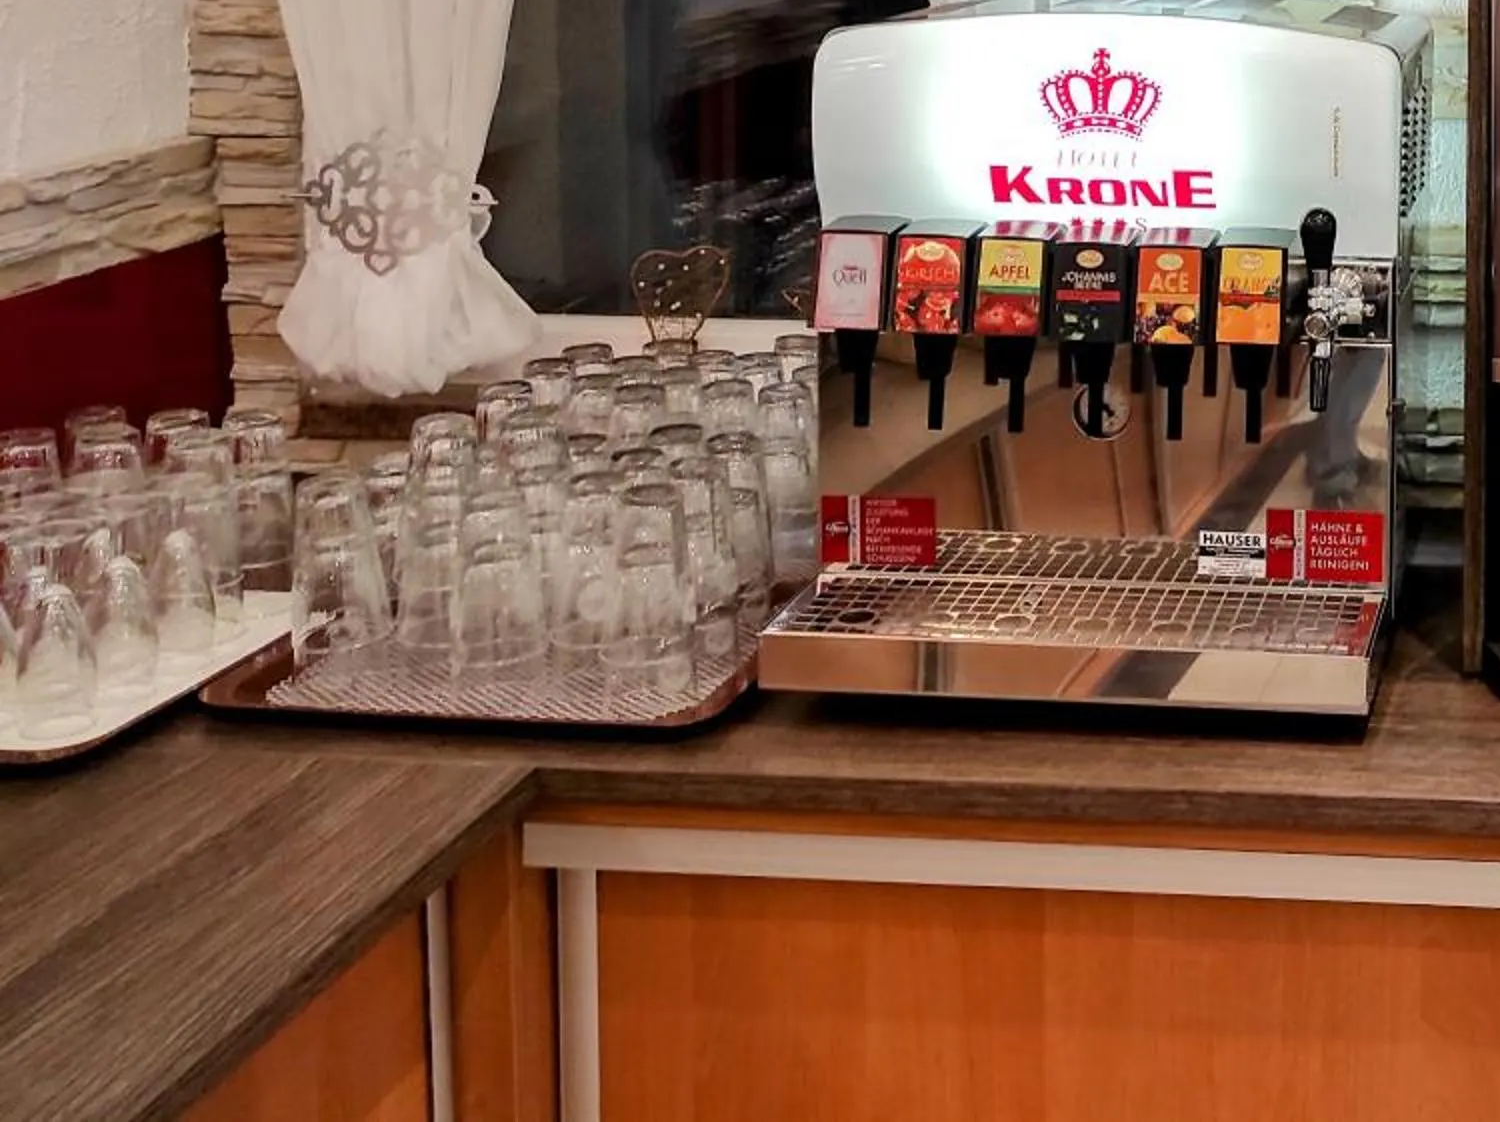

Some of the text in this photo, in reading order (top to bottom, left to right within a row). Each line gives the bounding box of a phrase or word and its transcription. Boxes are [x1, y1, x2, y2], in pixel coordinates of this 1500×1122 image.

[989, 164, 1217, 209] KRONE
[989, 263, 1031, 281] APFEL
[1147, 271, 1190, 293] ACE
[1310, 521, 1351, 534] HÄHNE
[1203, 533, 1262, 547] HAUSER
